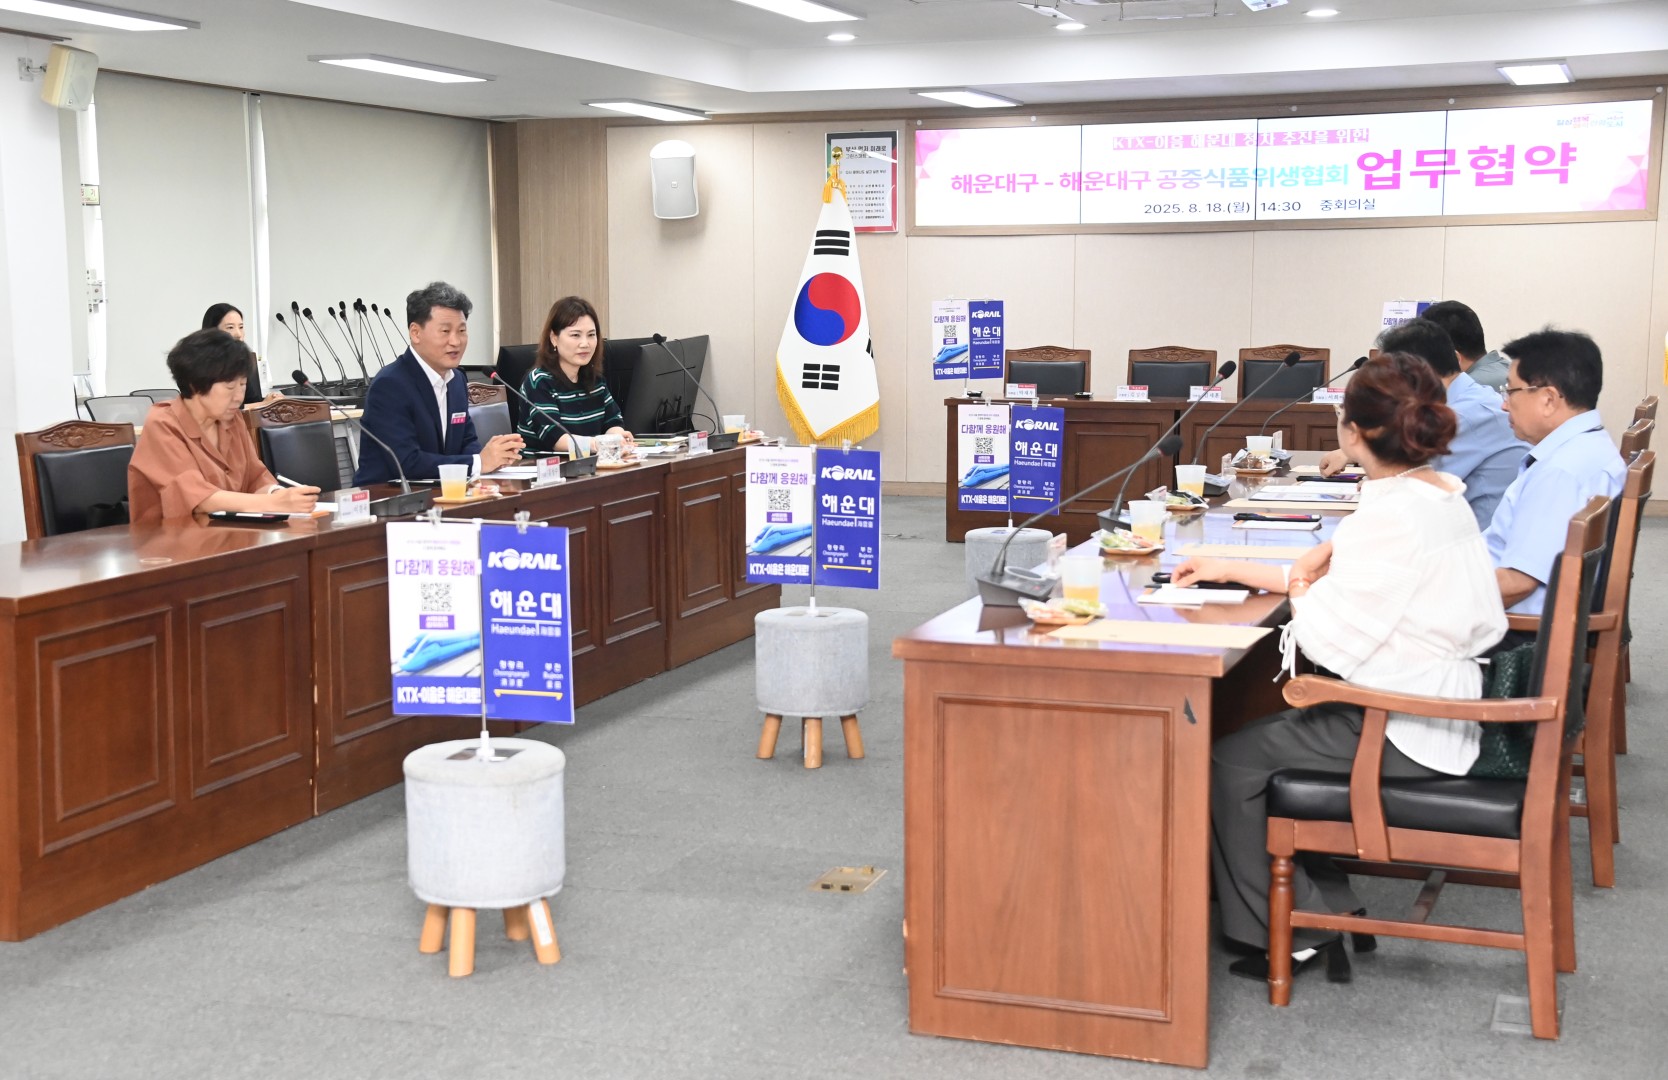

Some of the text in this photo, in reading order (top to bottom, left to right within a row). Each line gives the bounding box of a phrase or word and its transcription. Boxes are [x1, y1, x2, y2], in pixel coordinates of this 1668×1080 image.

[1113, 135, 1184, 149] KTX-이음
[1243, 131, 1275, 146] 정차
[1283, 129, 1328, 145] 추진을
[1335, 128, 1370, 143] 위한
[951, 173, 1039, 194] 해운대구
[1059, 170, 1151, 192] 해운대구
[1156, 163, 1349, 190] 공중식품위생협회
[1356, 142, 1577, 191] 업무협약
[1144, 203, 1184, 214] 2025.
[1188, 203, 1201, 213] 8.
[1260, 201, 1302, 212] 14:30
[1320, 198, 1376, 211] 중회의실
[972, 310, 1001, 319] KORAIL
[972, 326, 1001, 337] 해운대
[961, 424, 1007, 434] 다함께 응원해
[1015, 419, 1059, 431] KORAIL
[1015, 441, 1058, 457] 해운대
[750, 472, 808, 485] 다함께 응원해
[821, 465, 876, 481] KORAIL
[822, 493, 875, 515] 해운대
[822, 518, 854, 527] Haeundae
[395, 559, 475, 576] 다함께 응원해
[487, 548, 562, 571] KORAIL
[490, 589, 562, 619] 해운대
[491, 623, 536, 637] Haeundae
